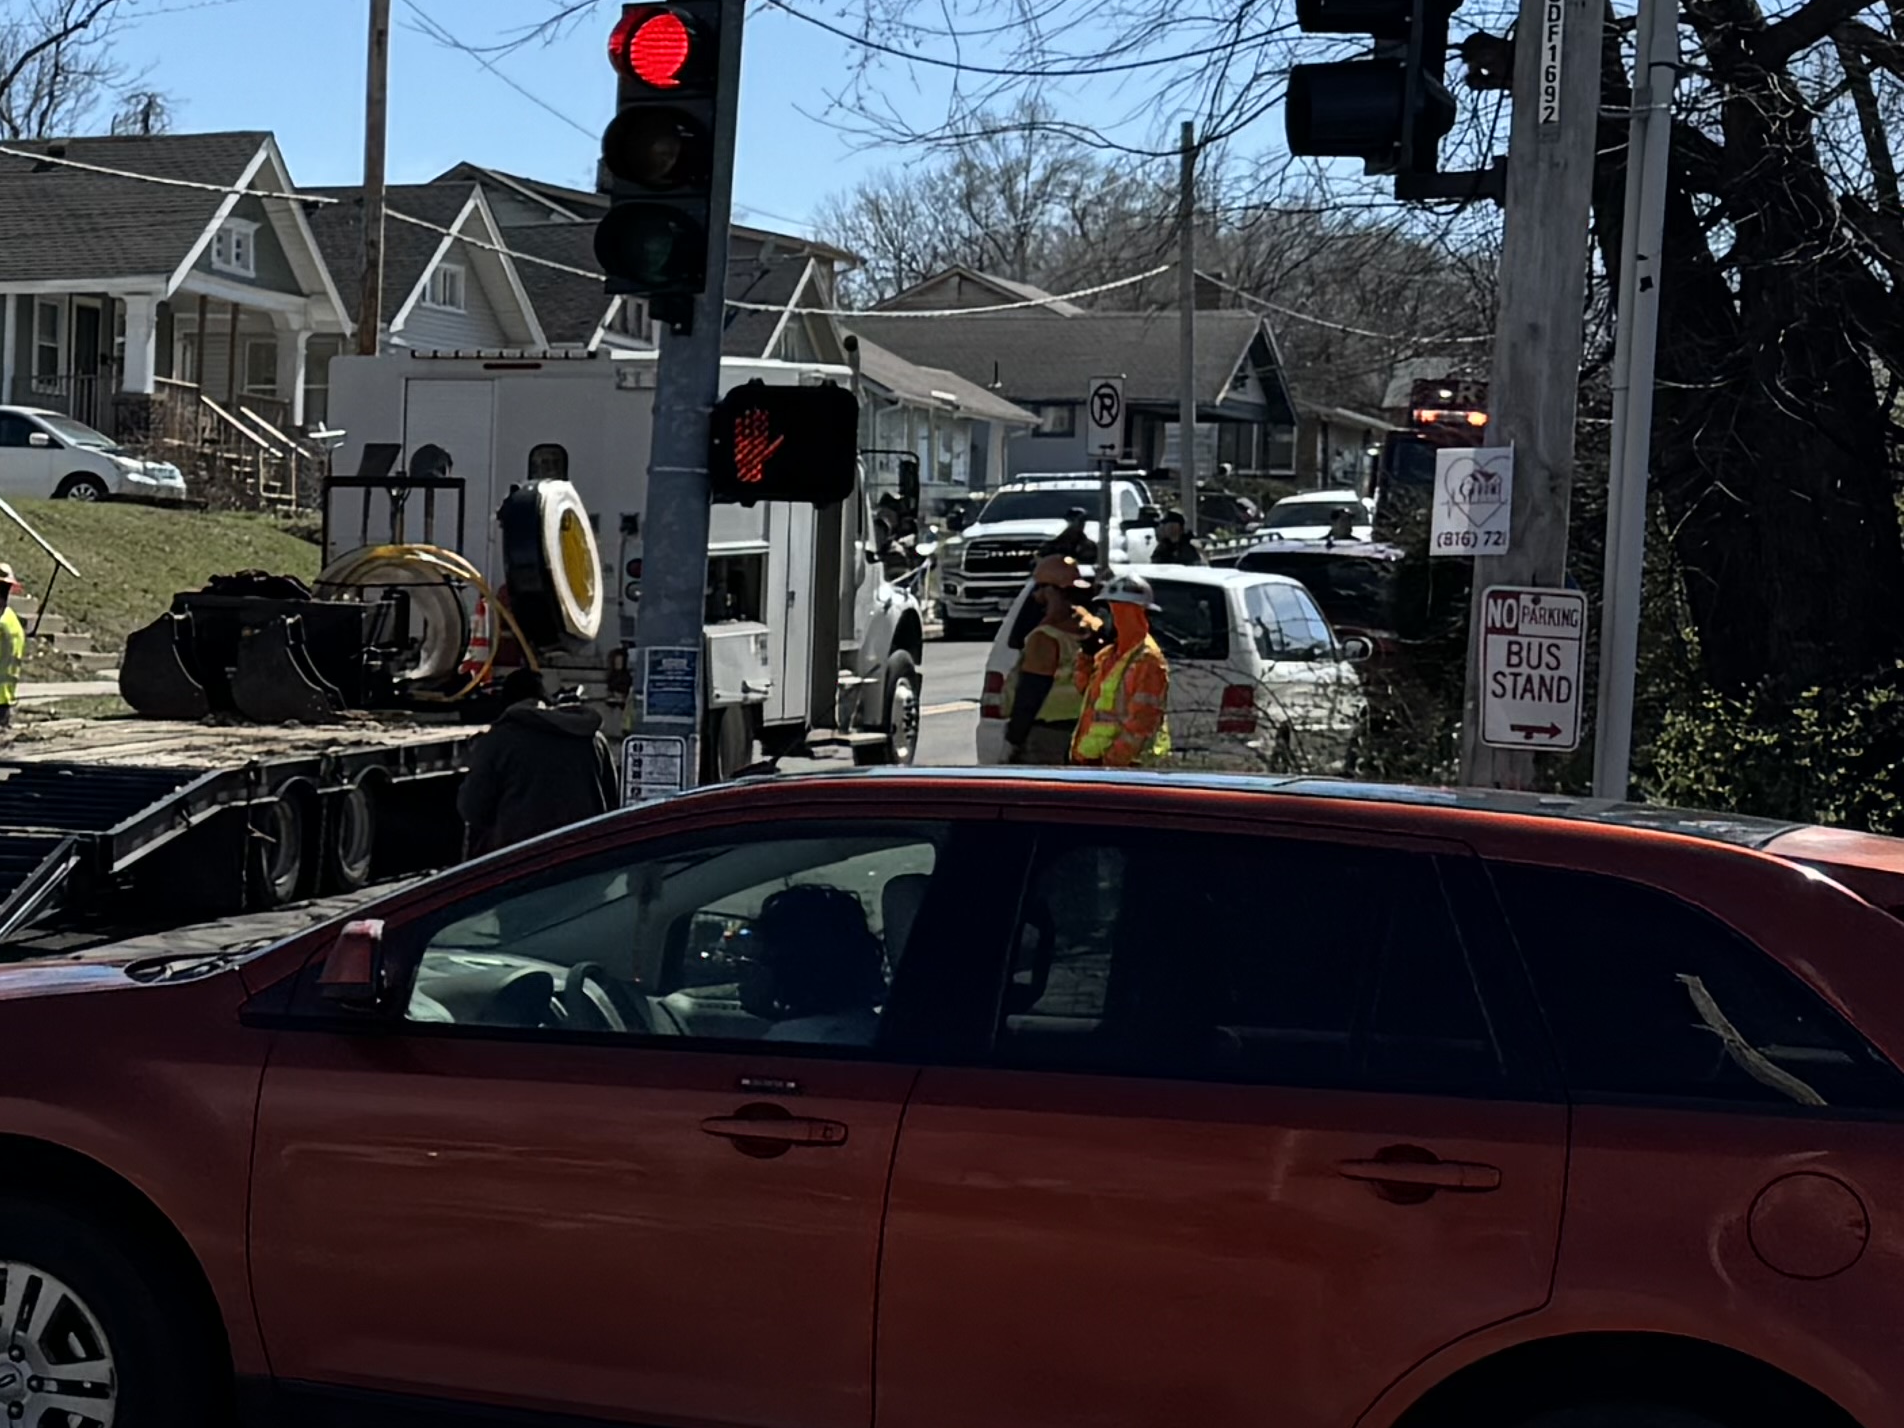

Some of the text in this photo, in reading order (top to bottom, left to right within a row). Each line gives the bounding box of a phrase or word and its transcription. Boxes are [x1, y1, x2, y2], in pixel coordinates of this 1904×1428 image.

[1437, 531, 1478, 549] (816)
[1487, 598, 1579, 629] NO PARKING
[1506, 640, 1561, 671] BUS
[1491, 670, 1572, 704] STAND
